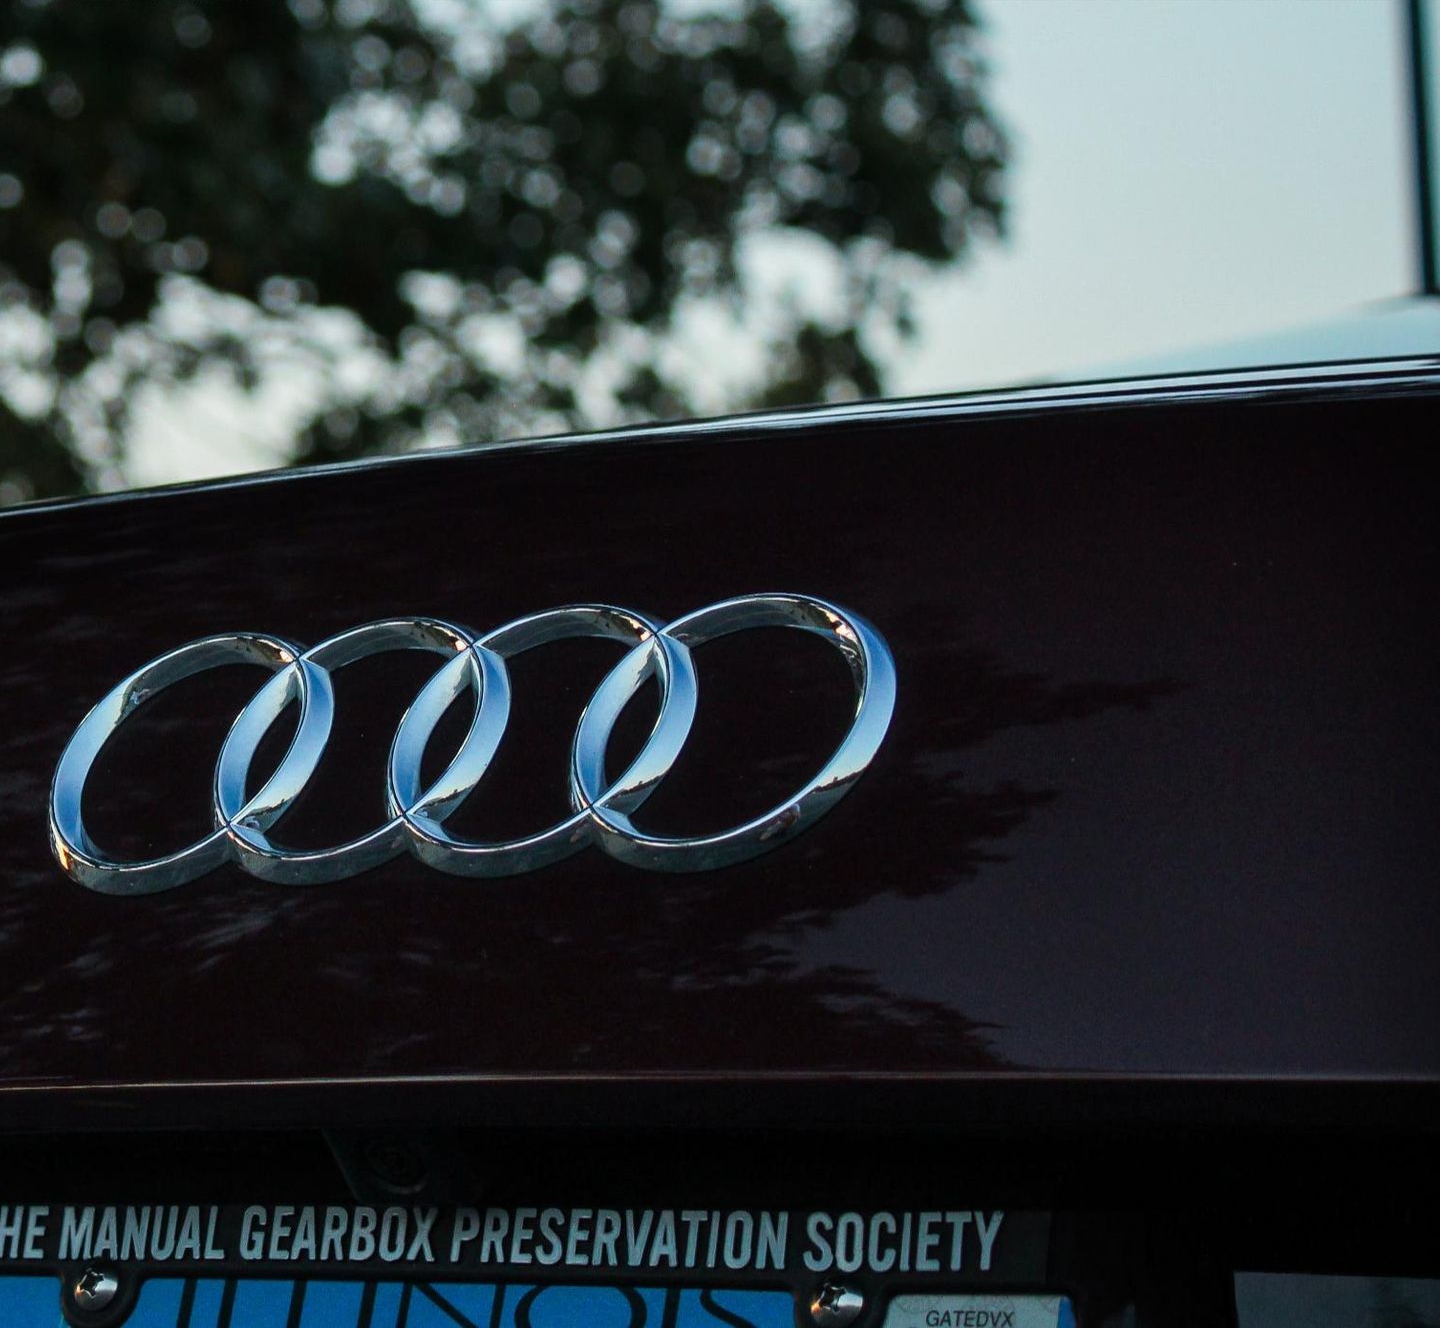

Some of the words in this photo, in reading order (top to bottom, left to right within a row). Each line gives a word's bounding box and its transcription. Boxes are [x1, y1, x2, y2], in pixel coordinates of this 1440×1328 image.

[58, 1205, 225, 1261] MANUAL
[239, 1206, 436, 1262] GEARBOX
[450, 1208, 788, 1270] PRESERVATION
[803, 1211, 1004, 1271] SOCIETY
[925, 1310, 1015, 1328] GATEDVX
